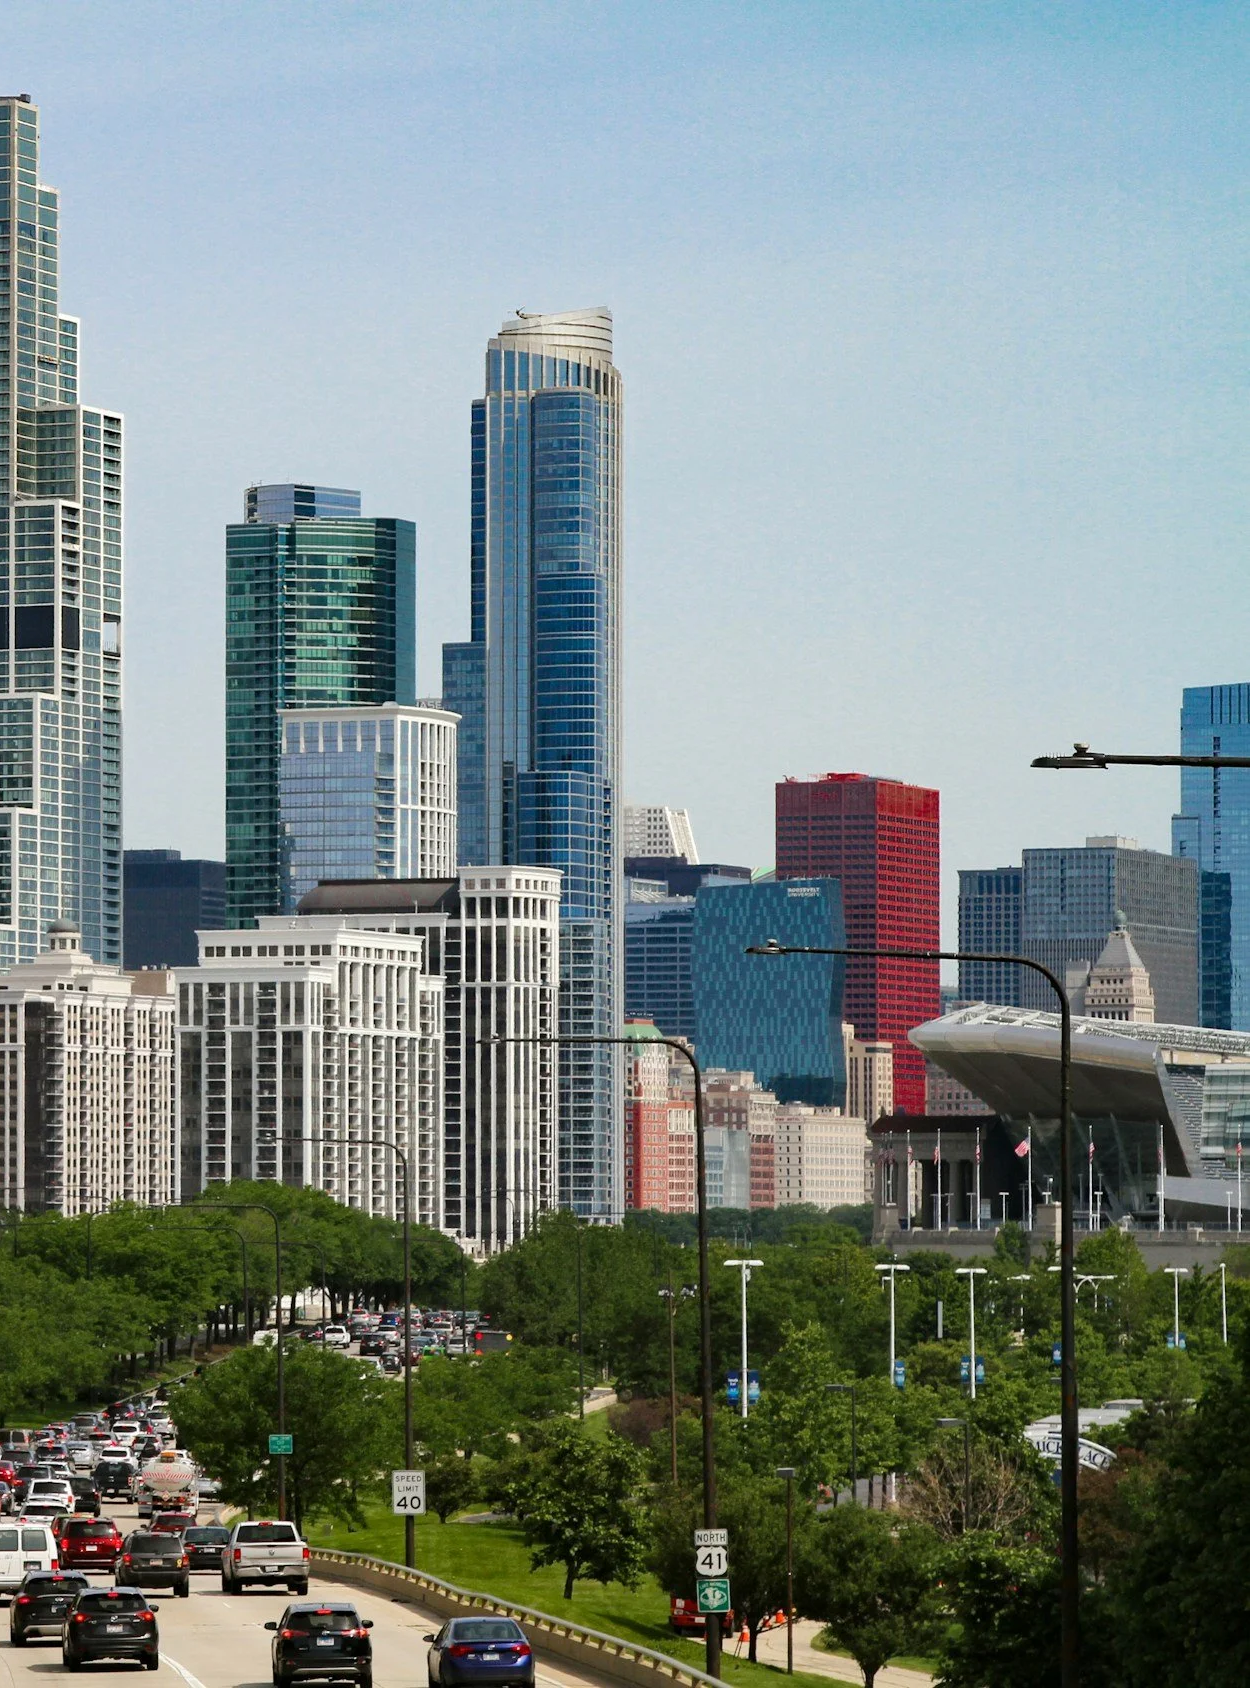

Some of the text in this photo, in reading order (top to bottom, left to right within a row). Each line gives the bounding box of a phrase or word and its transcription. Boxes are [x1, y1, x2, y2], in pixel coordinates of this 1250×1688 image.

[396, 1496, 421, 1510] 40
[696, 1533, 726, 1543] NORTH
[701, 1553, 722, 1570] 41
